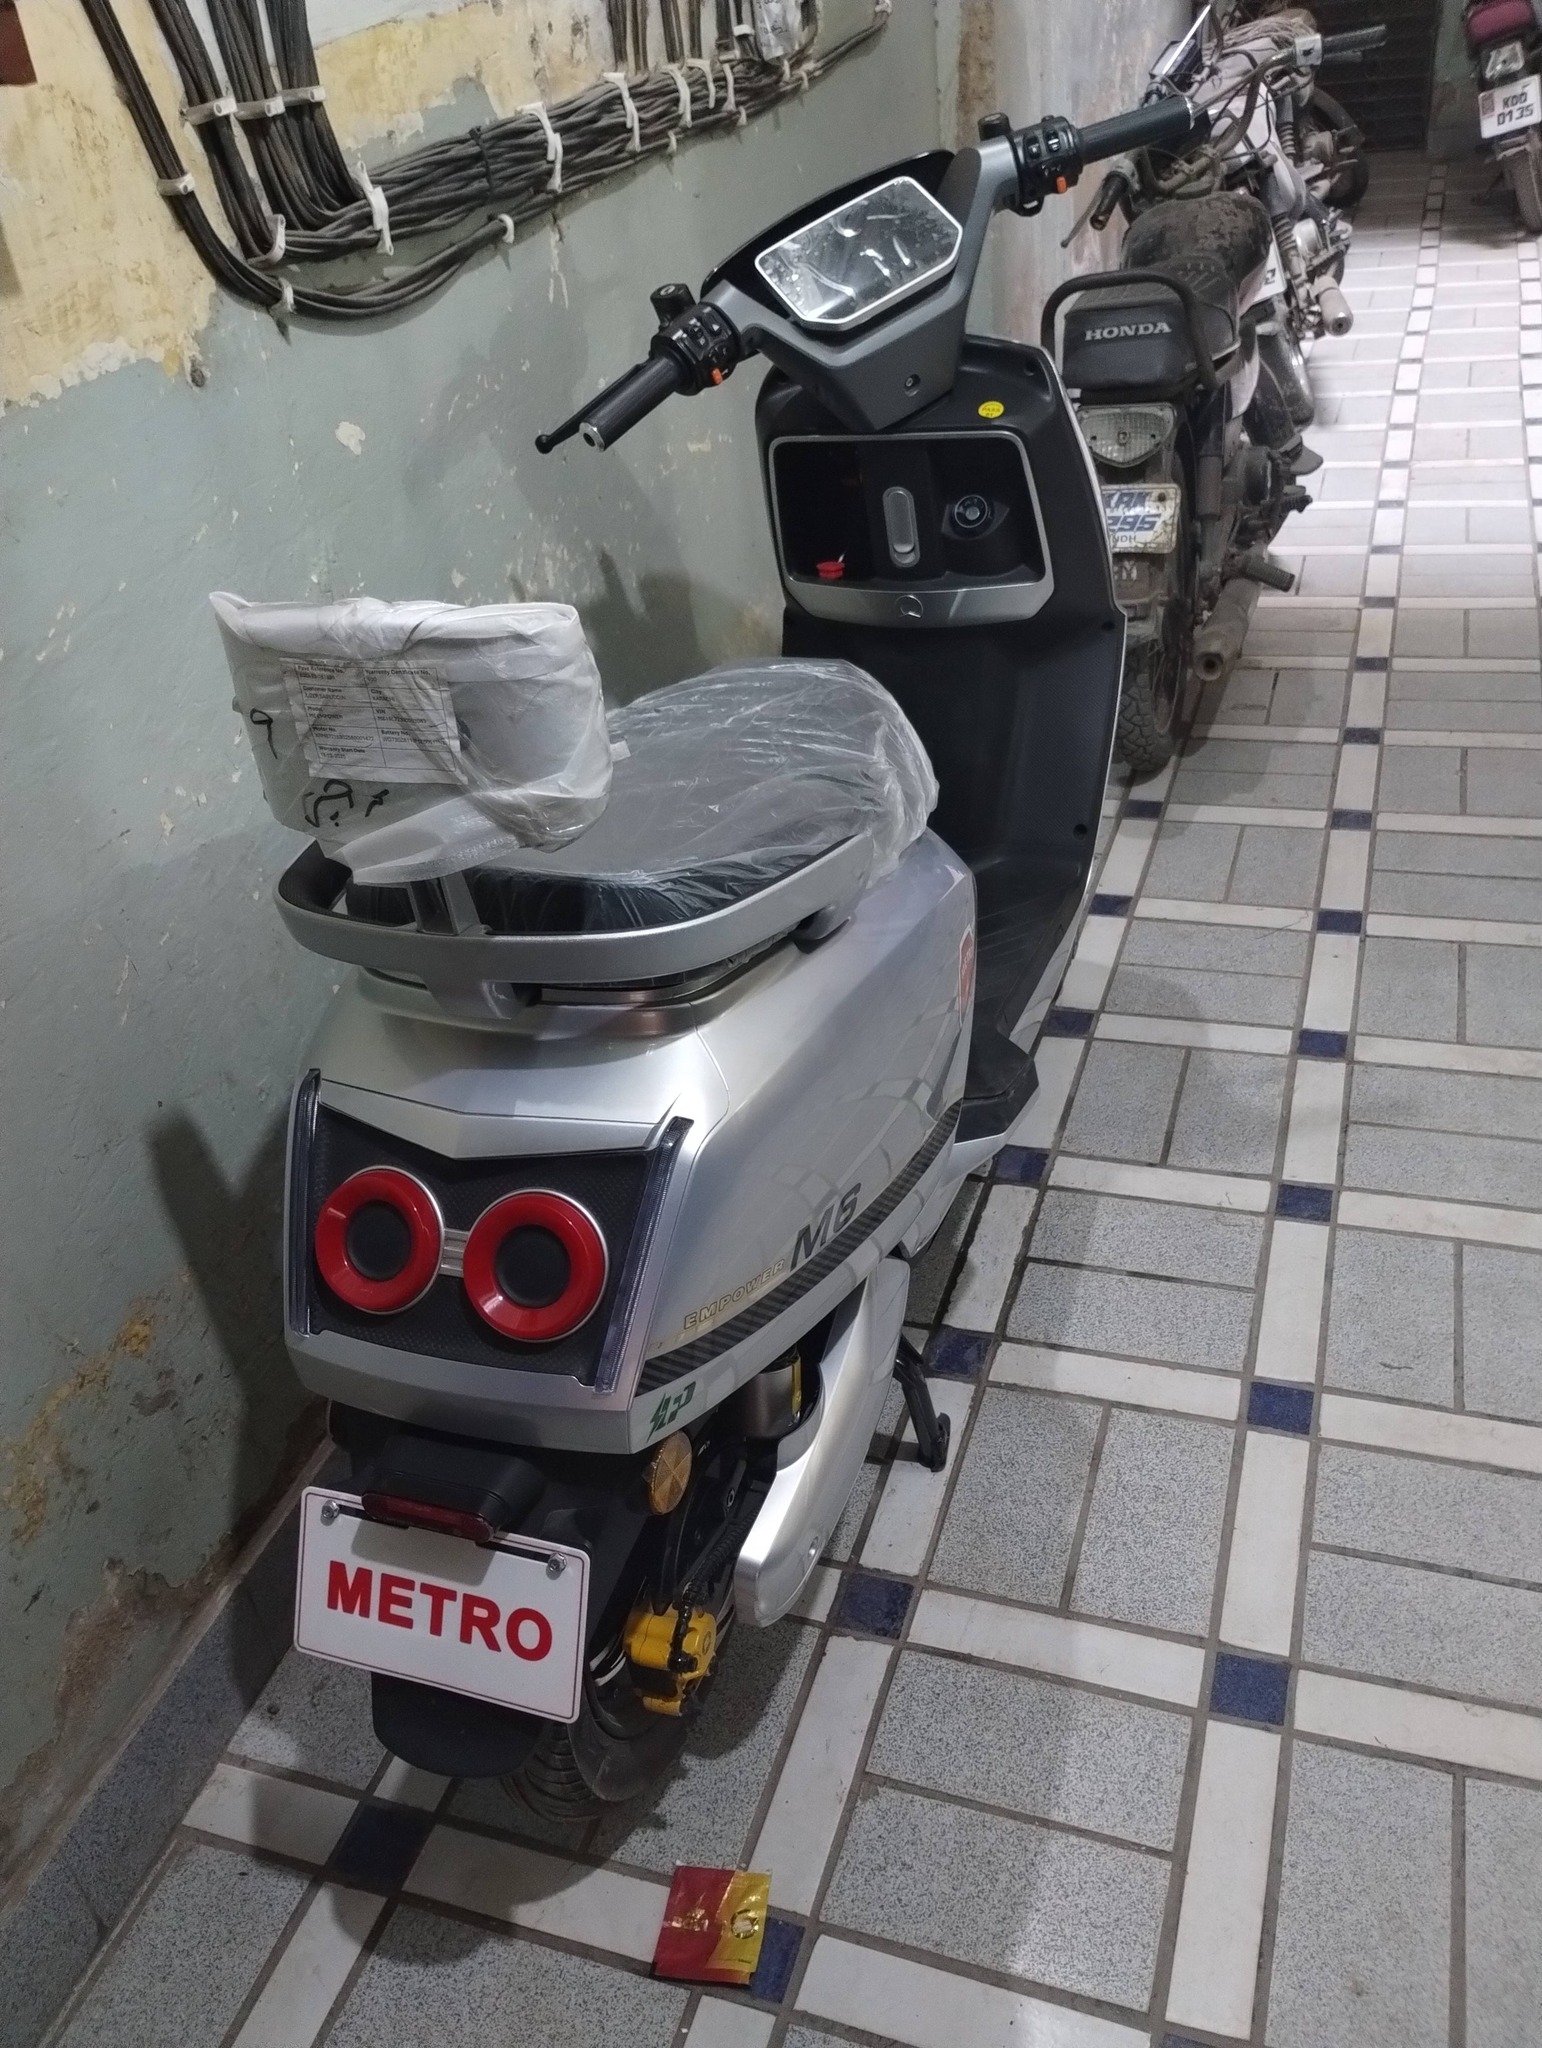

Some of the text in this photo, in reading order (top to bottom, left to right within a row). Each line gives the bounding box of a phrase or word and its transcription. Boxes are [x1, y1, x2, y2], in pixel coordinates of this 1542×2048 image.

[1084, 321, 1173, 342] HONDA
[684, 1258, 785, 1331] EMPOWER
[327, 1560, 553, 1662] METRO
